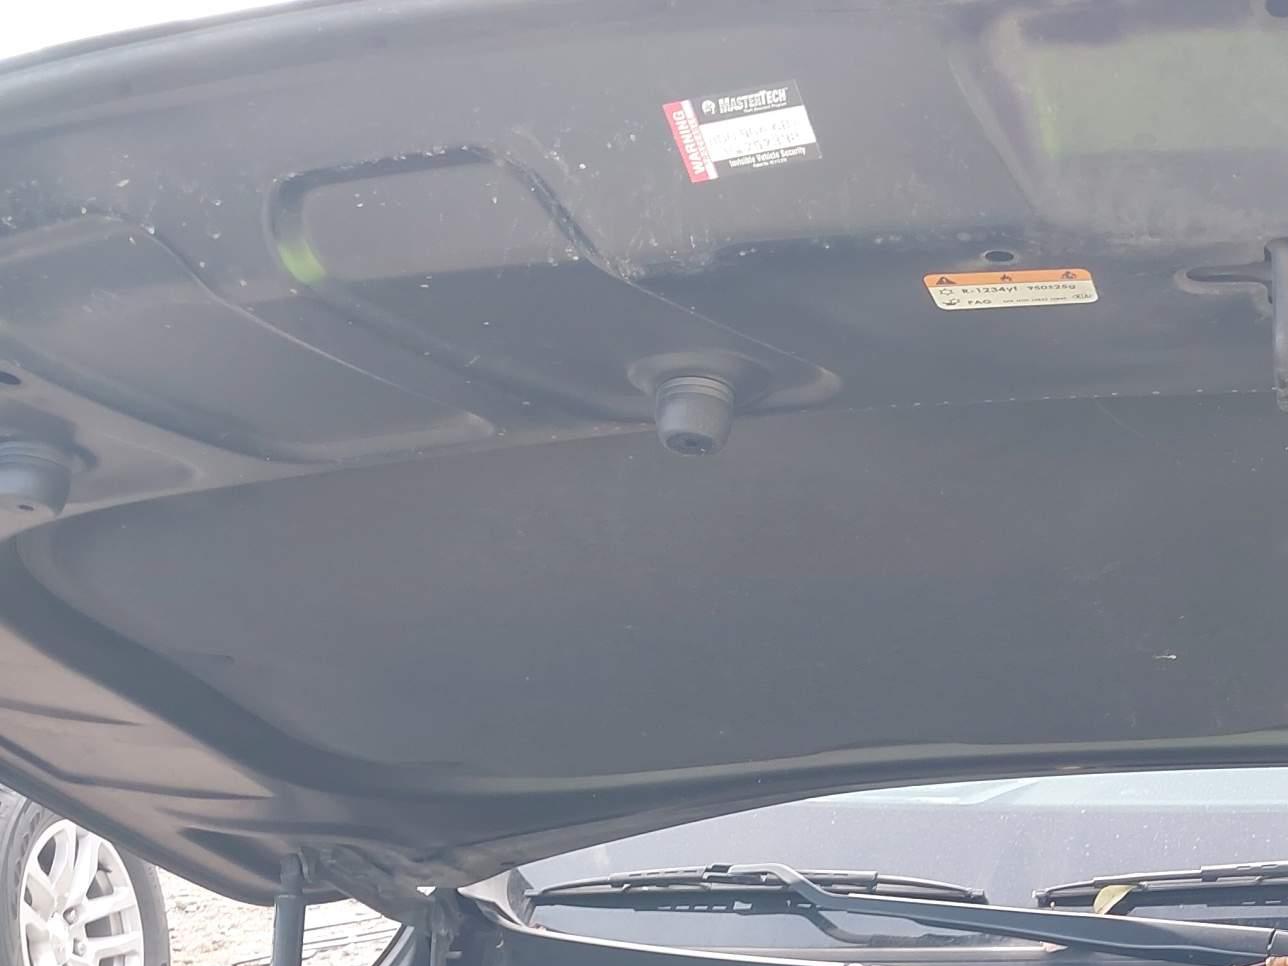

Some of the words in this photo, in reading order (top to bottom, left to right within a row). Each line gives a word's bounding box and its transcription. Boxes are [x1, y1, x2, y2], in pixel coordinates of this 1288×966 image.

[672, 111, 705, 174] WARNING
[756, 151, 780, 163] Vehicle
[781, 147, 806, 160] Security
[961, 286, 1018, 294] R-1234yf
